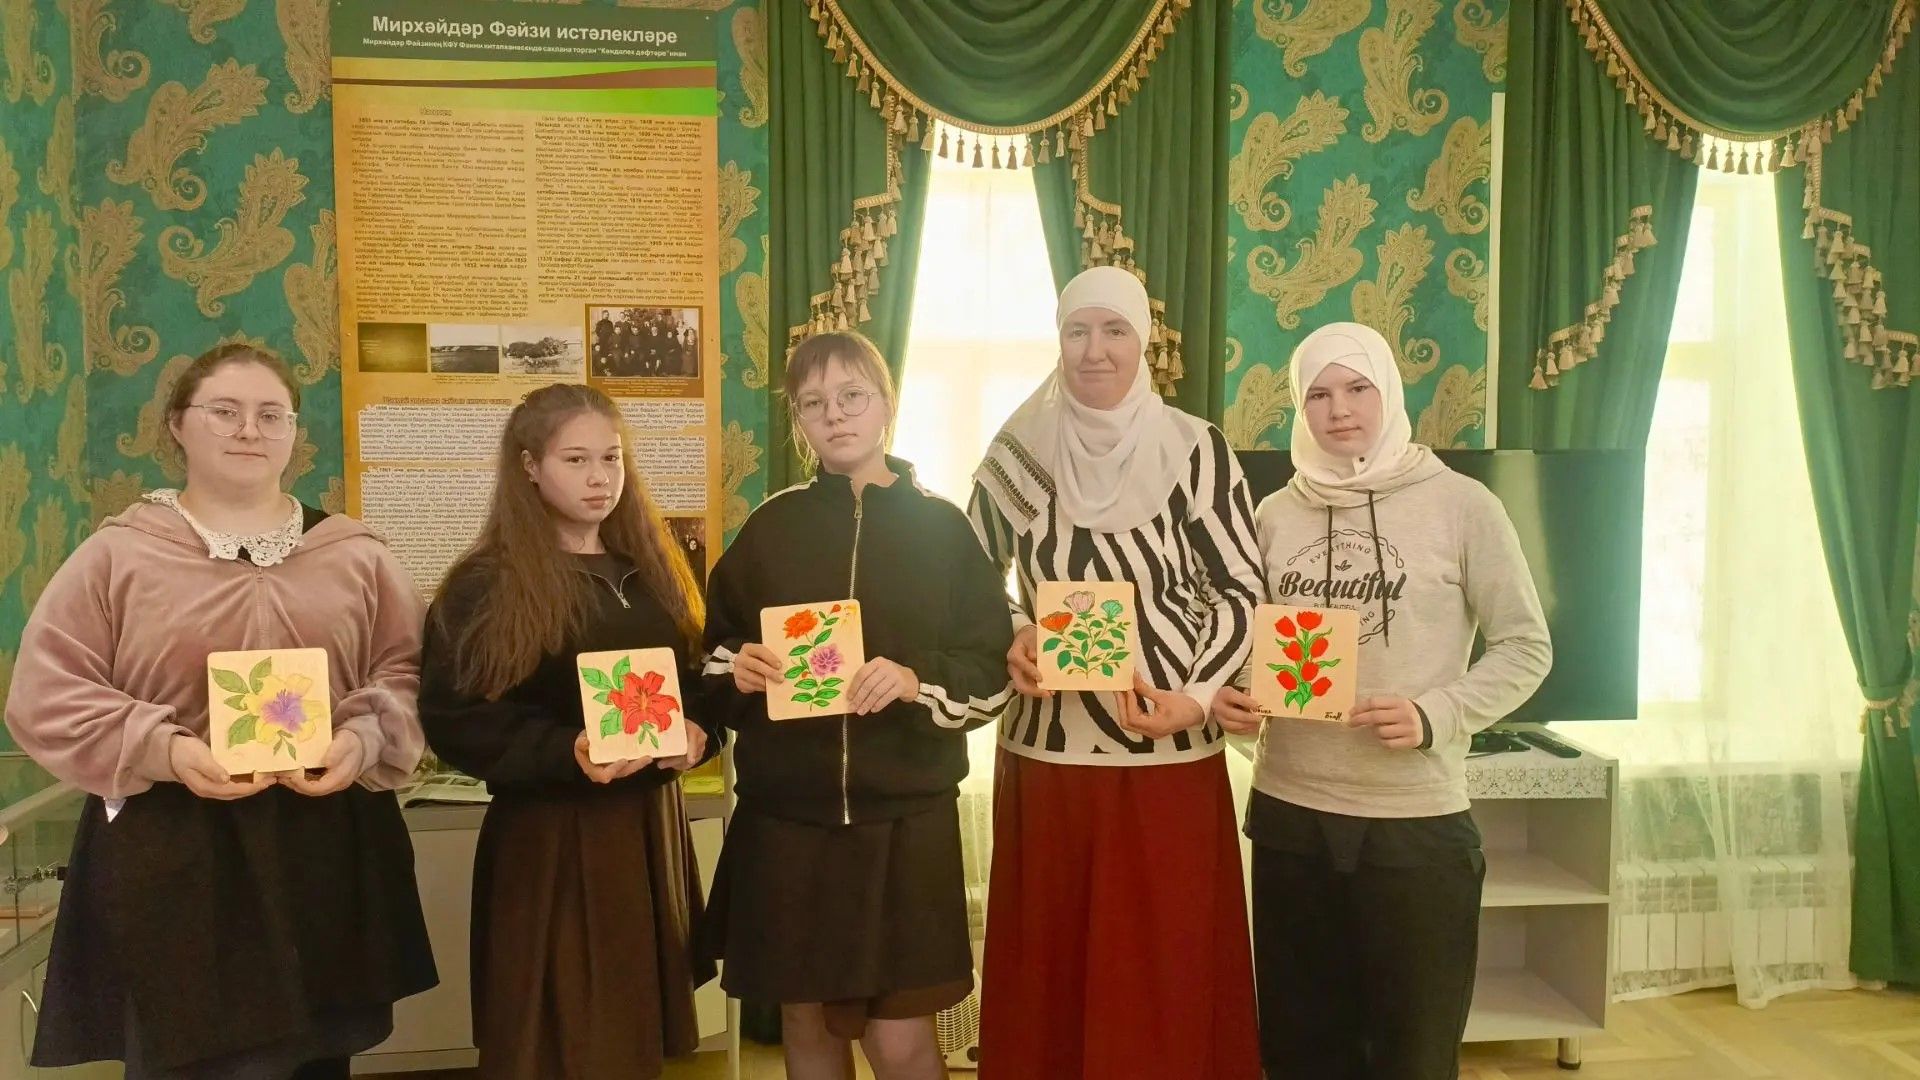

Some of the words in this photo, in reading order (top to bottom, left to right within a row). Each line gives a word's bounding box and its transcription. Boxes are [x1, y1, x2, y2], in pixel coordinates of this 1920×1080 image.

[372, 15, 484, 38] Мирхәйдәр
[489, 20, 550, 38] Фәйзи
[557, 26, 678, 46] истәлекләре
[1278, 571, 1407, 605] Beautiful
